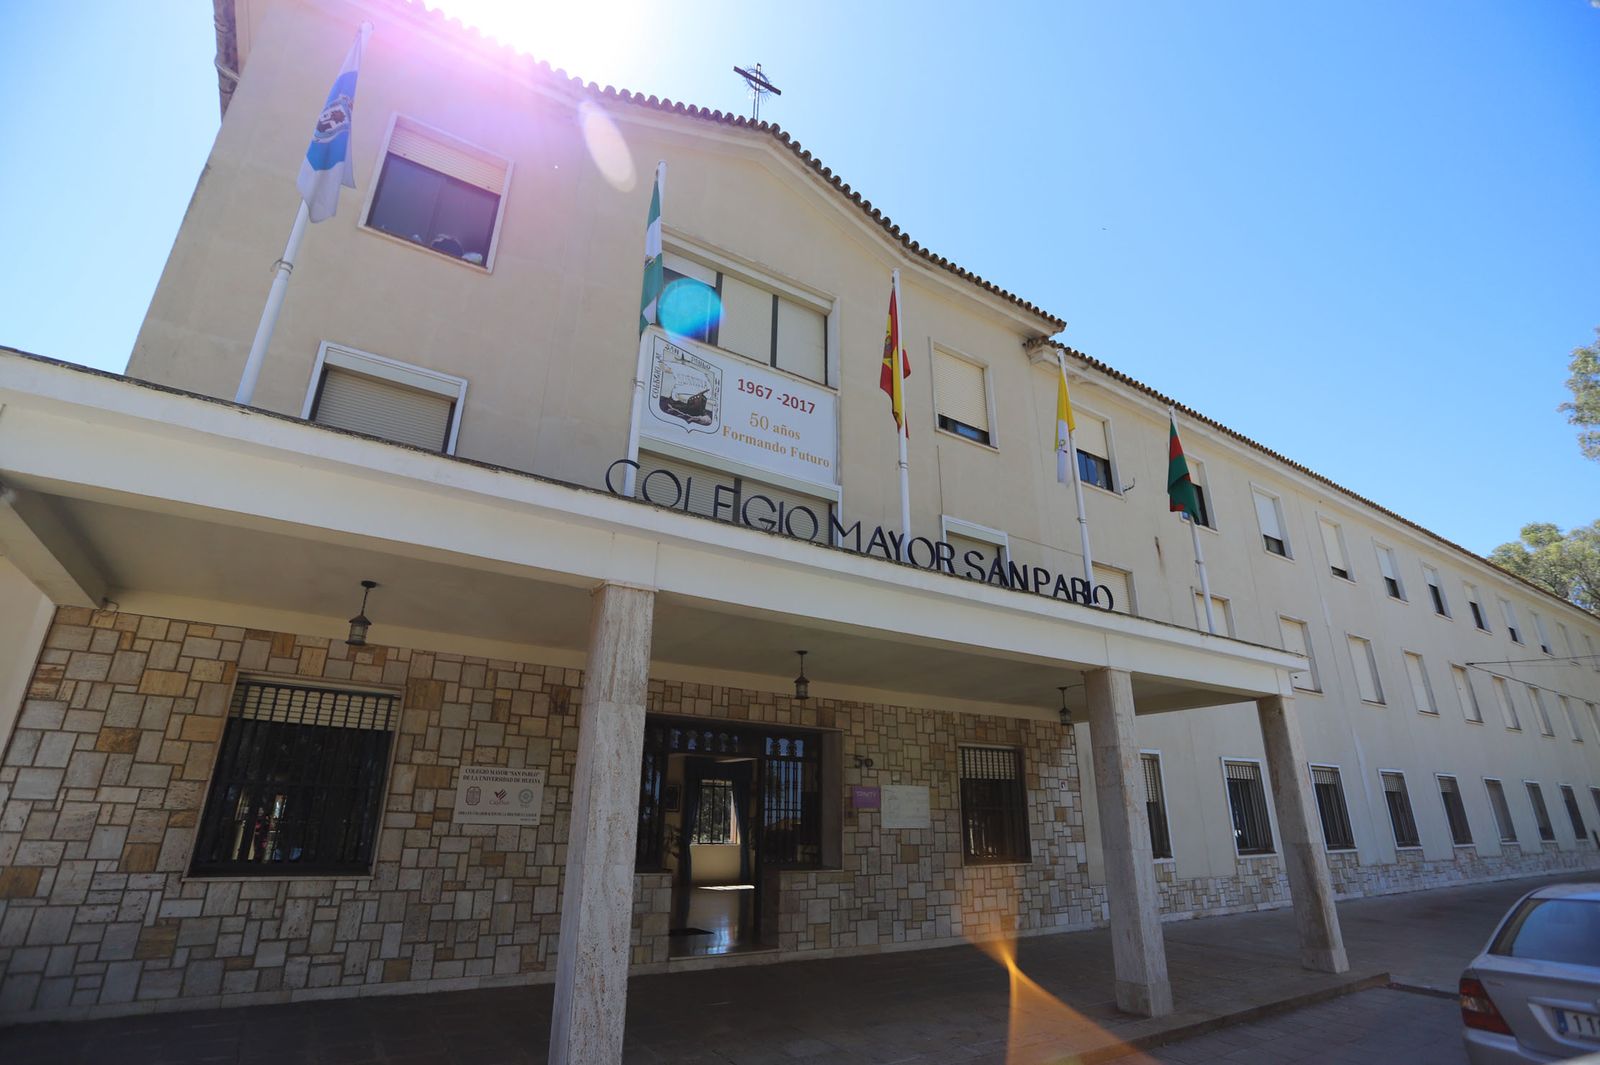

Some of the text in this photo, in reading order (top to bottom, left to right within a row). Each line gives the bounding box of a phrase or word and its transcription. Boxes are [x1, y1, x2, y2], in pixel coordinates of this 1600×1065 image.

[737, 378, 773, 400] 1967
[749, 412, 801, 440] 50 años
[722, 425, 830, 468] Formando Futuro
[605, 459, 819, 541] COLEGIO
[828, 510, 956, 575] MAYOR
[963, 550, 1029, 592] SAN
[1573, 1015, 1600, 1034] 11
